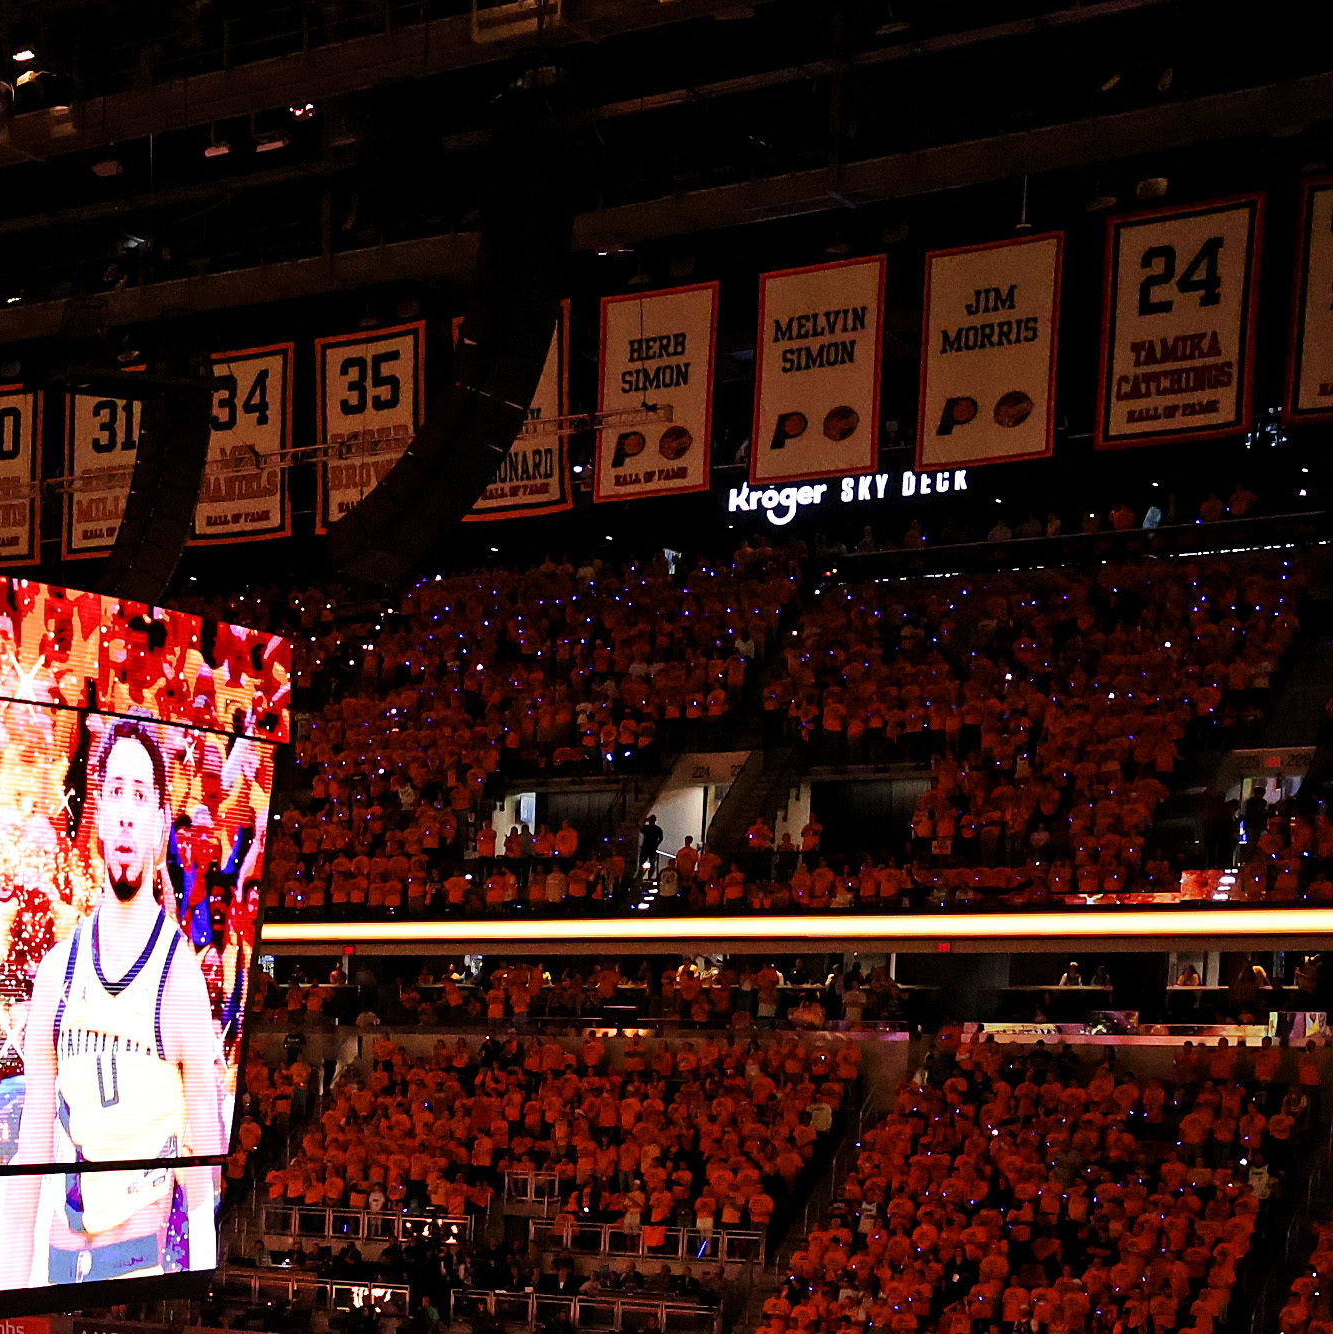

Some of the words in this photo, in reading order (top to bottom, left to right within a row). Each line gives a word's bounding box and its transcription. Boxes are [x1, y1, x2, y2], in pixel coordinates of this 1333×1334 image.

[1138, 236, 1225, 317] 24
[965, 284, 1018, 316] JIM
[771, 305, 868, 343] MELVIN
[939, 316, 1039, 355] MORRIS
[628, 331, 688, 363] HERB
[781, 339, 857, 374] SIMON
[1130, 330, 1223, 368] TAMIKA
[339, 349, 401, 416] 35
[620, 362, 692, 395] SIMON
[1115, 360, 1234, 402] CATCHINGS
[210, 368, 270, 432] 34
[91, 399, 137, 454] 31
[493, 447, 554, 485] ONARD
[727, 482, 828, 526] Kroger
[840, 473, 889, 503] SKY
